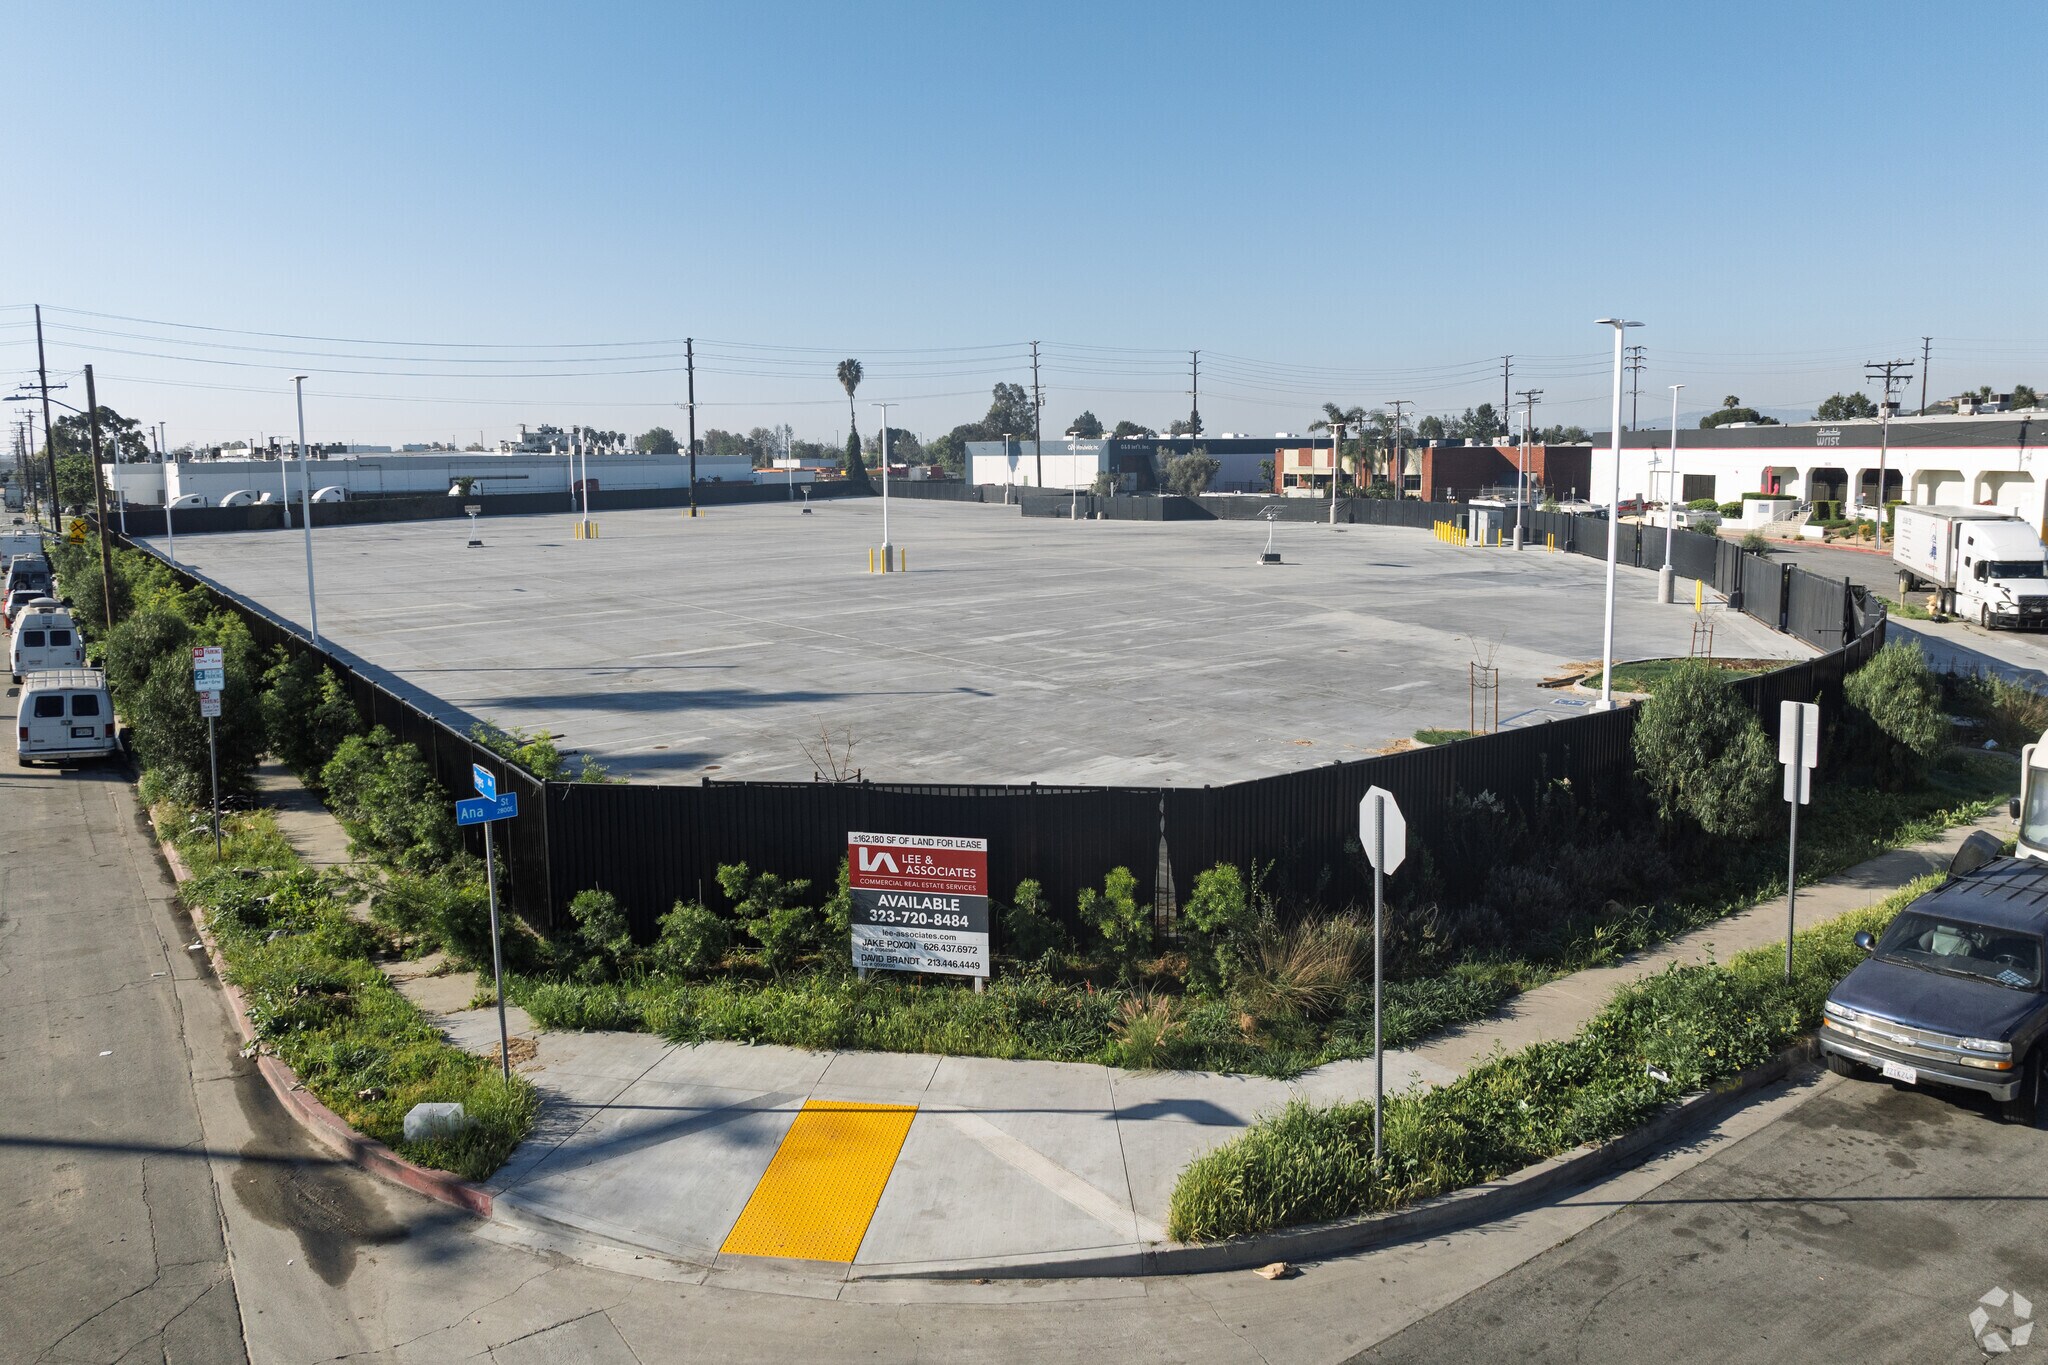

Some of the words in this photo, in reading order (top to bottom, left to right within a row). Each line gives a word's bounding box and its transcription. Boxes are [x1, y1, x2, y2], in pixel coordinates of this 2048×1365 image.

[197, 671, 203, 679] 2
[461, 807, 484, 820] Ana
[500, 797, 509, 806] St
[887, 836, 897, 844] SF
[899, 836, 910, 845] OF
[912, 837, 934, 846] LAND
[936, 838, 953, 847] FOR
[955, 839, 982, 849] LEASE
[902, 854, 921, 864] LEE
[925, 855, 933, 865] &
[906, 866, 976, 878] ASSOCIATES
[860, 878, 903, 887] COMMERCIAL
[904, 880, 920, 888] REAL
[946, 883, 976, 891] SERVICES
[877, 894, 960, 911] AVAILABLE
[869, 909, 969, 927] 323-720-8484
[882, 929, 956, 941] lee-associates.com
[862, 939, 884, 948] JAKE
[887, 940, 916, 950] POXON
[923, 943, 978, 954] 626.437.6972
[861, 954, 884, 963] DAVID
[886, 955, 920, 965] BRANDT
[927, 958, 980, 970] 213.446.4449
